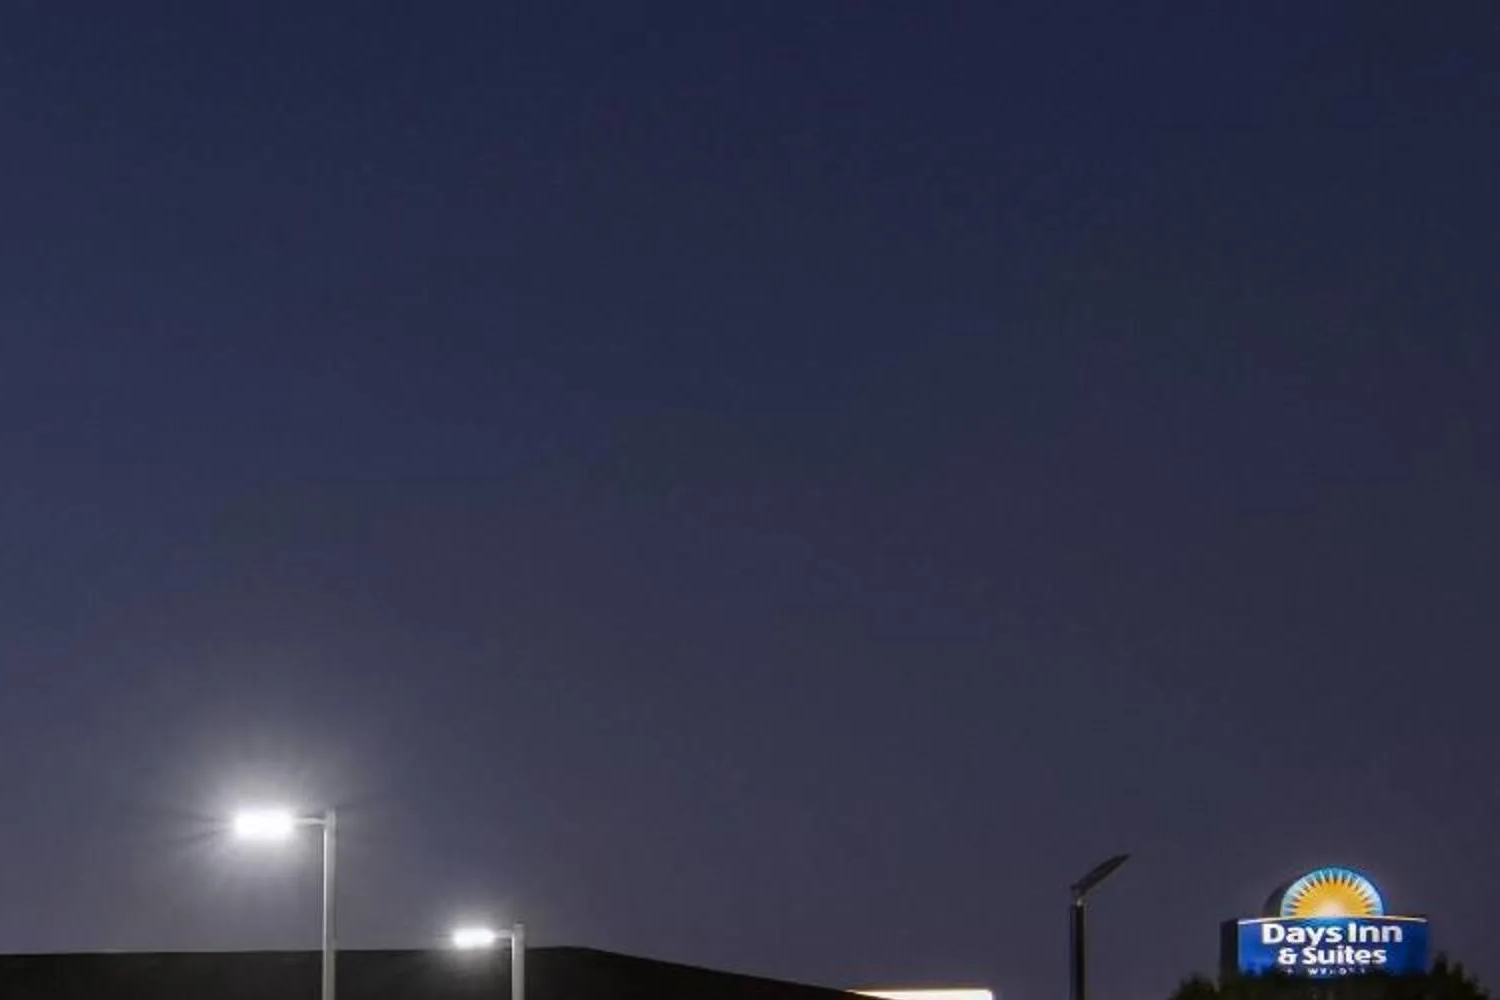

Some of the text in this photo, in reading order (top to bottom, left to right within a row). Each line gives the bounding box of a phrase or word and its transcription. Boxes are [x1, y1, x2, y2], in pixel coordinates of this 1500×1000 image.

[1261, 922, 1403, 946] Days Inn
[1277, 945, 1387, 965] & Suites
